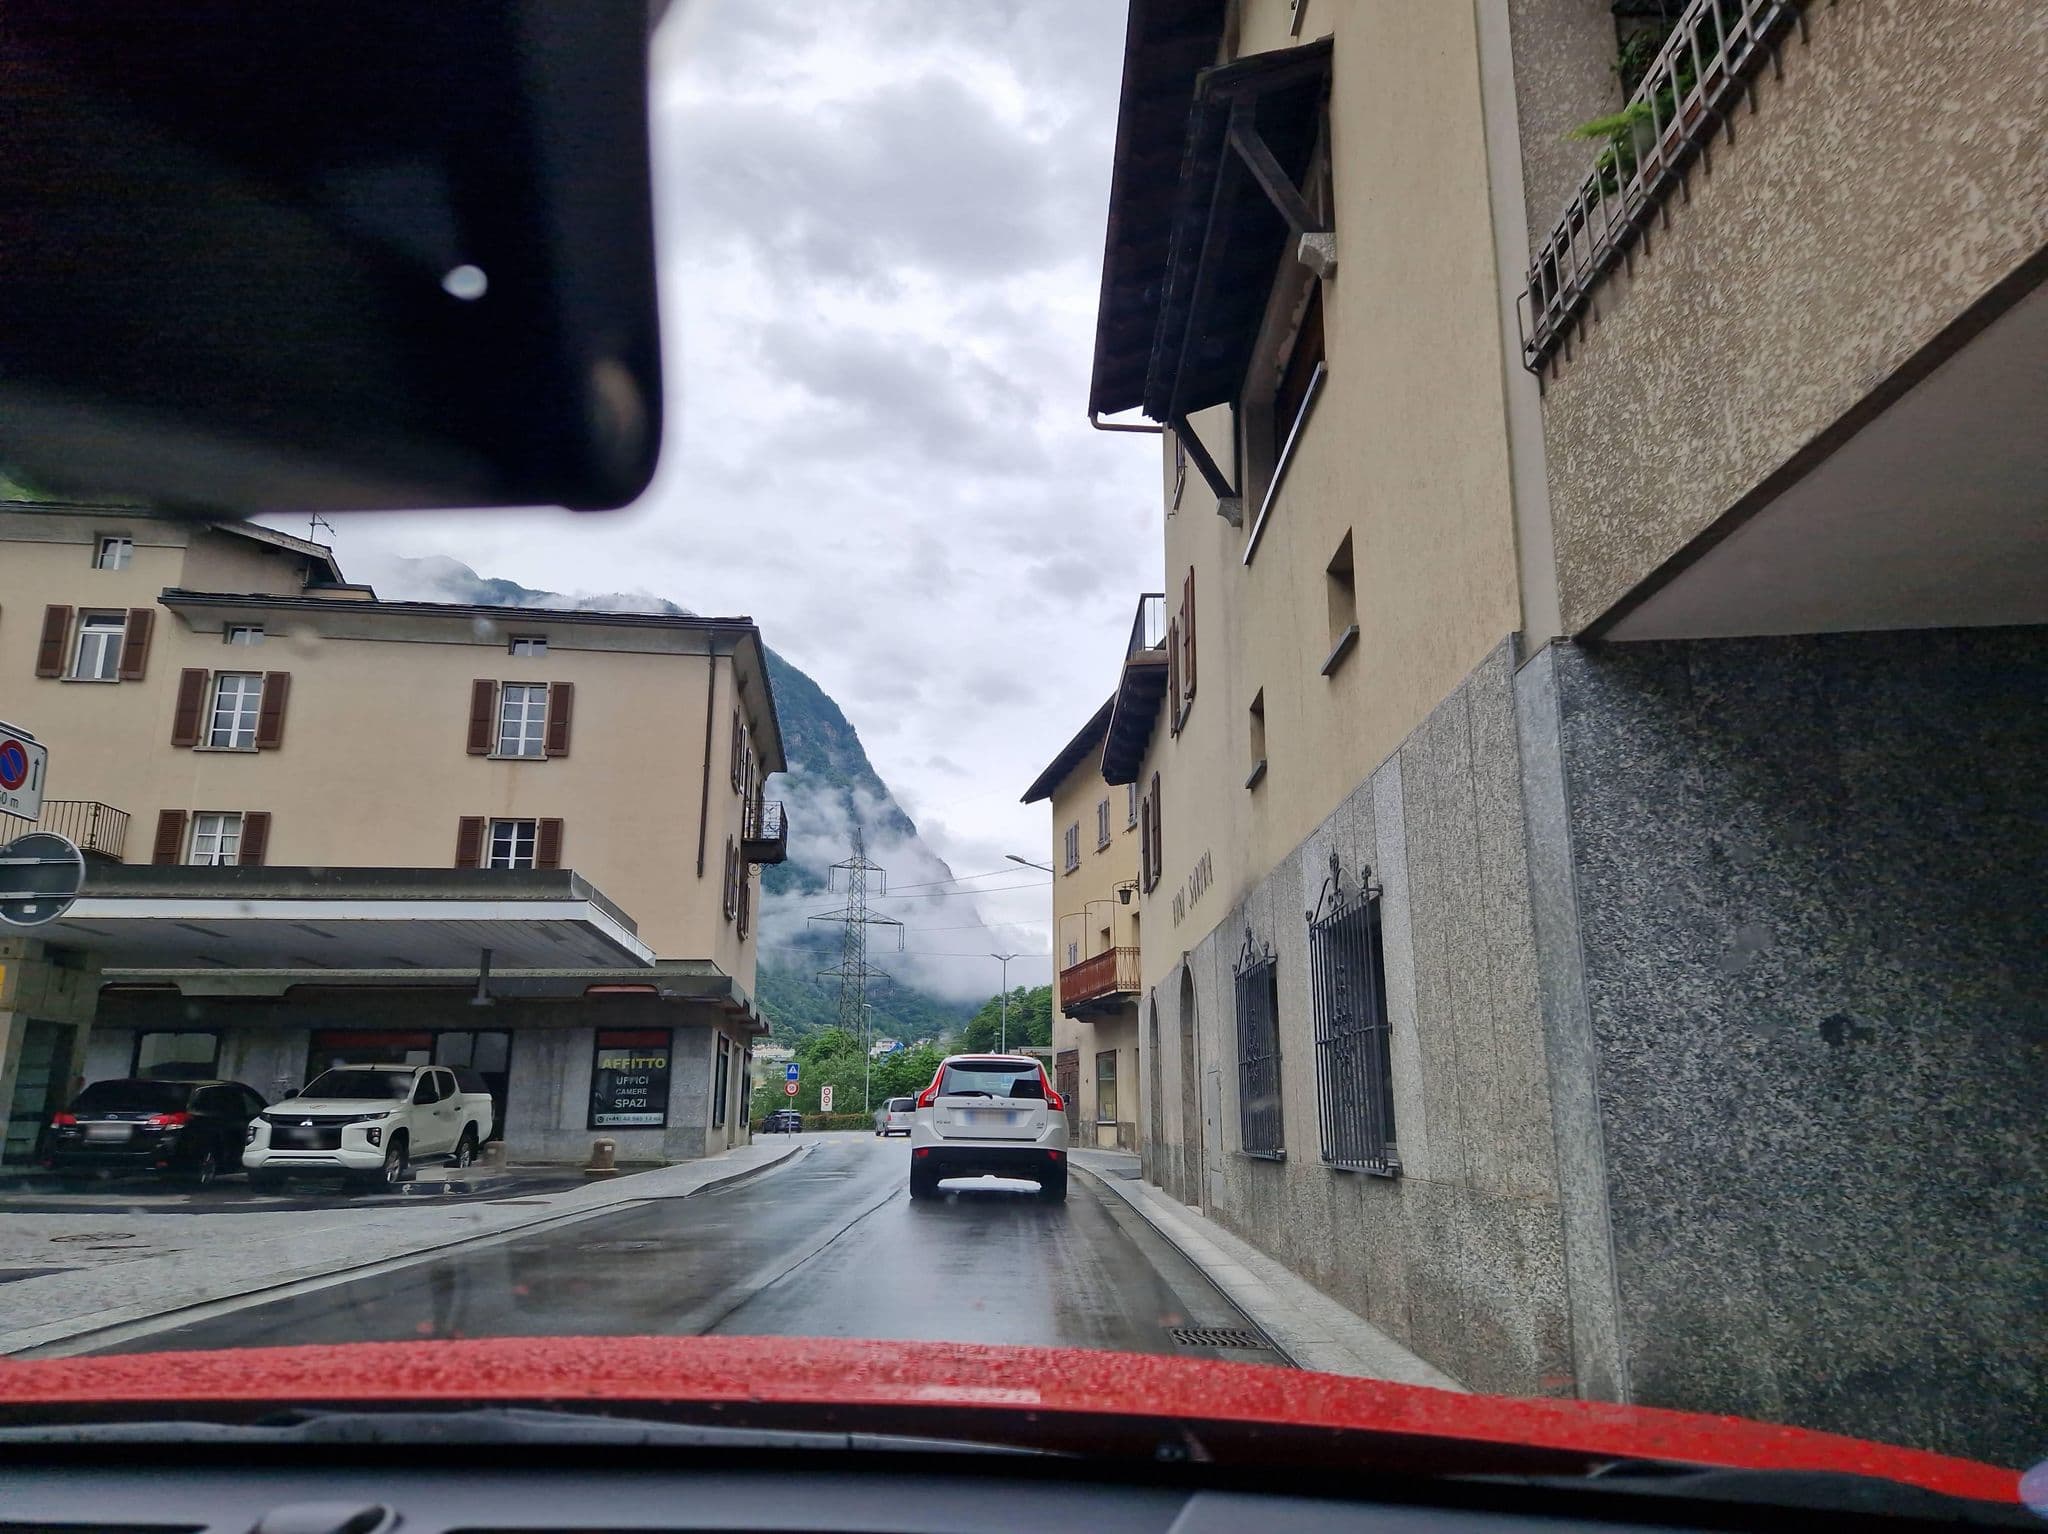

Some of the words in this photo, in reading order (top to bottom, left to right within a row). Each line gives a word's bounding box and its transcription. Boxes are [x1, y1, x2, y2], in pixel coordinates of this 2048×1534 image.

[10, 797, 19, 809] m
[601, 1058, 666, 1069] AFFITTO
[616, 1076, 648, 1085] UFFICI
[615, 1099, 646, 1108] SPAZI
